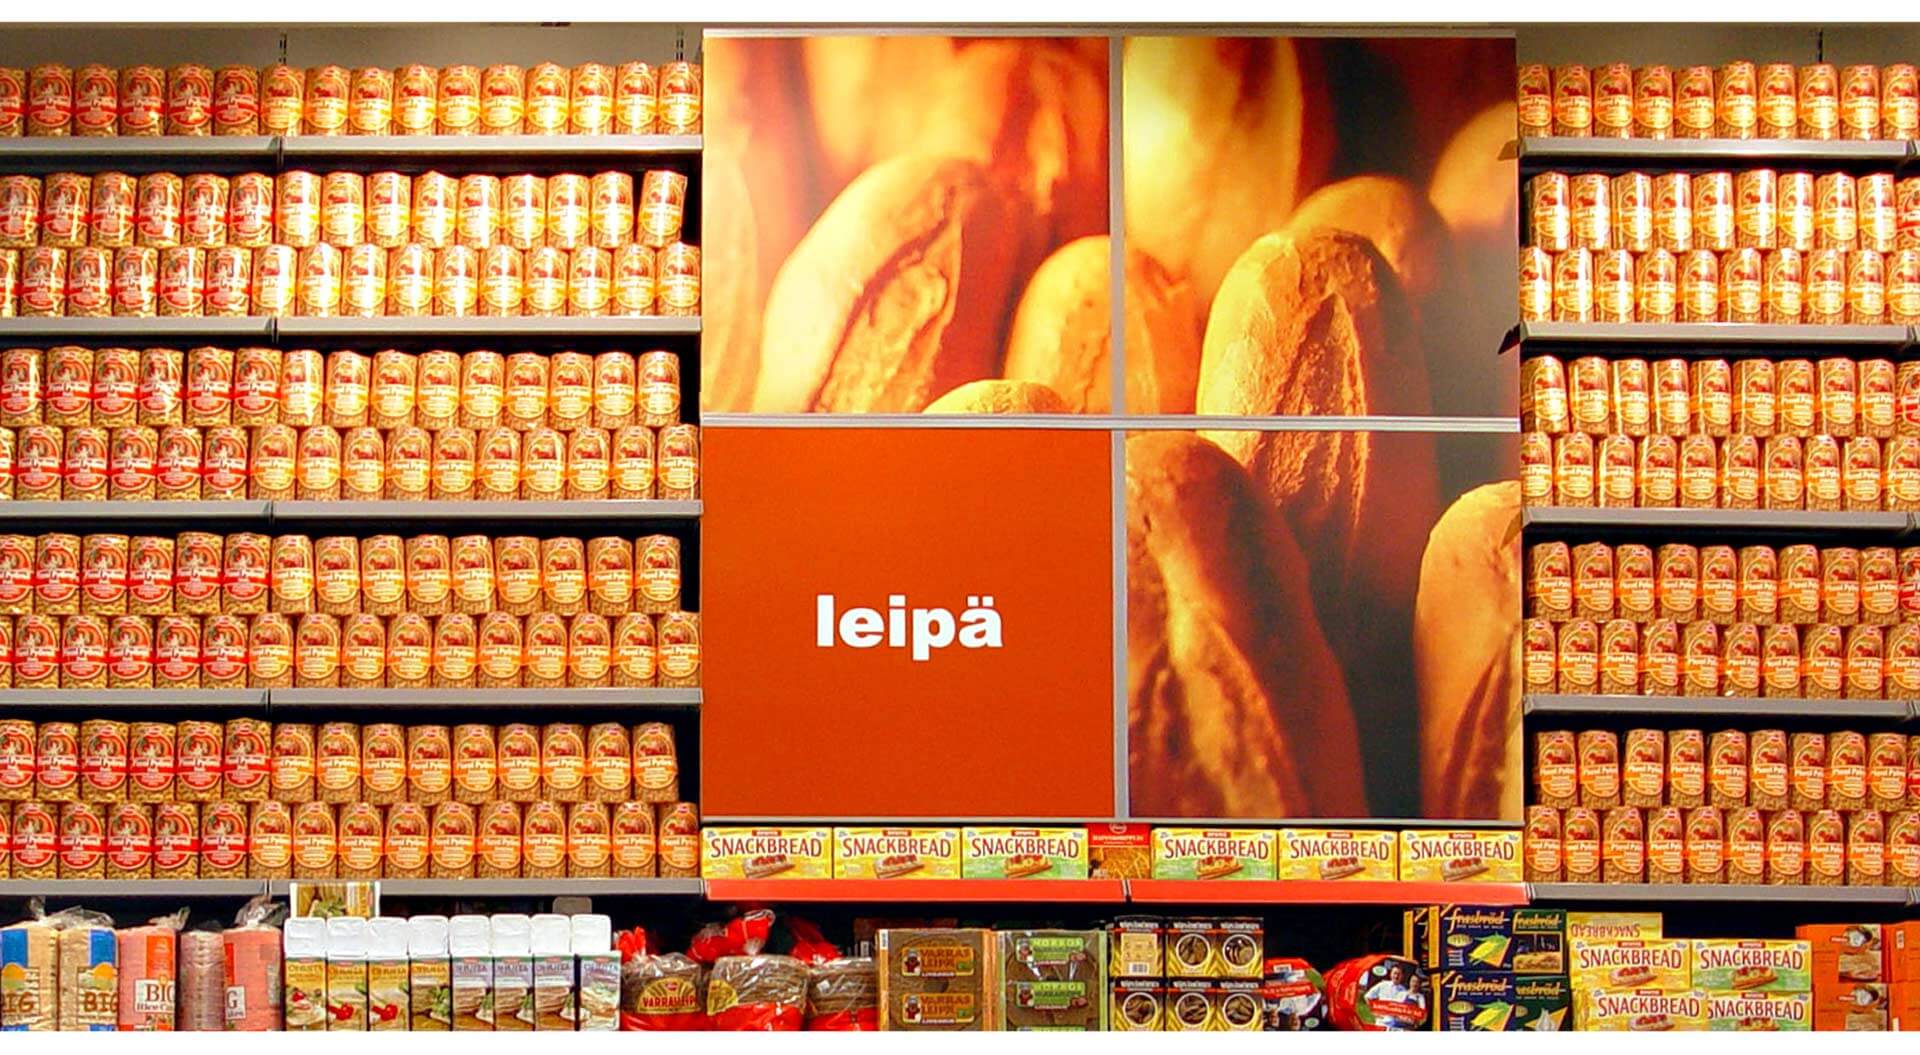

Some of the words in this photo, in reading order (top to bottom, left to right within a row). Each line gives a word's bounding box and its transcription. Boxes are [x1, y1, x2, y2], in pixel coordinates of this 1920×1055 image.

[816, 595, 1003, 661] leipä
[711, 837, 821, 858] SNACKBREAD
[842, 837, 951, 858] SNACKBREAD
[971, 837, 1079, 858] SNACKBREAD
[1165, 839, 1269, 860] SNACKBREAD
[1290, 839, 1390, 860] SNACKBREAD
[1411, 839, 1514, 861] SNACKBREAD
[1580, 948, 1682, 969] SNACKBREAD
[1699, 948, 1803, 970] SNACKBREAD
[1598, 996, 1700, 1018] SNACKBREAD
[1707, 999, 1804, 1021] SNACKBREAD
